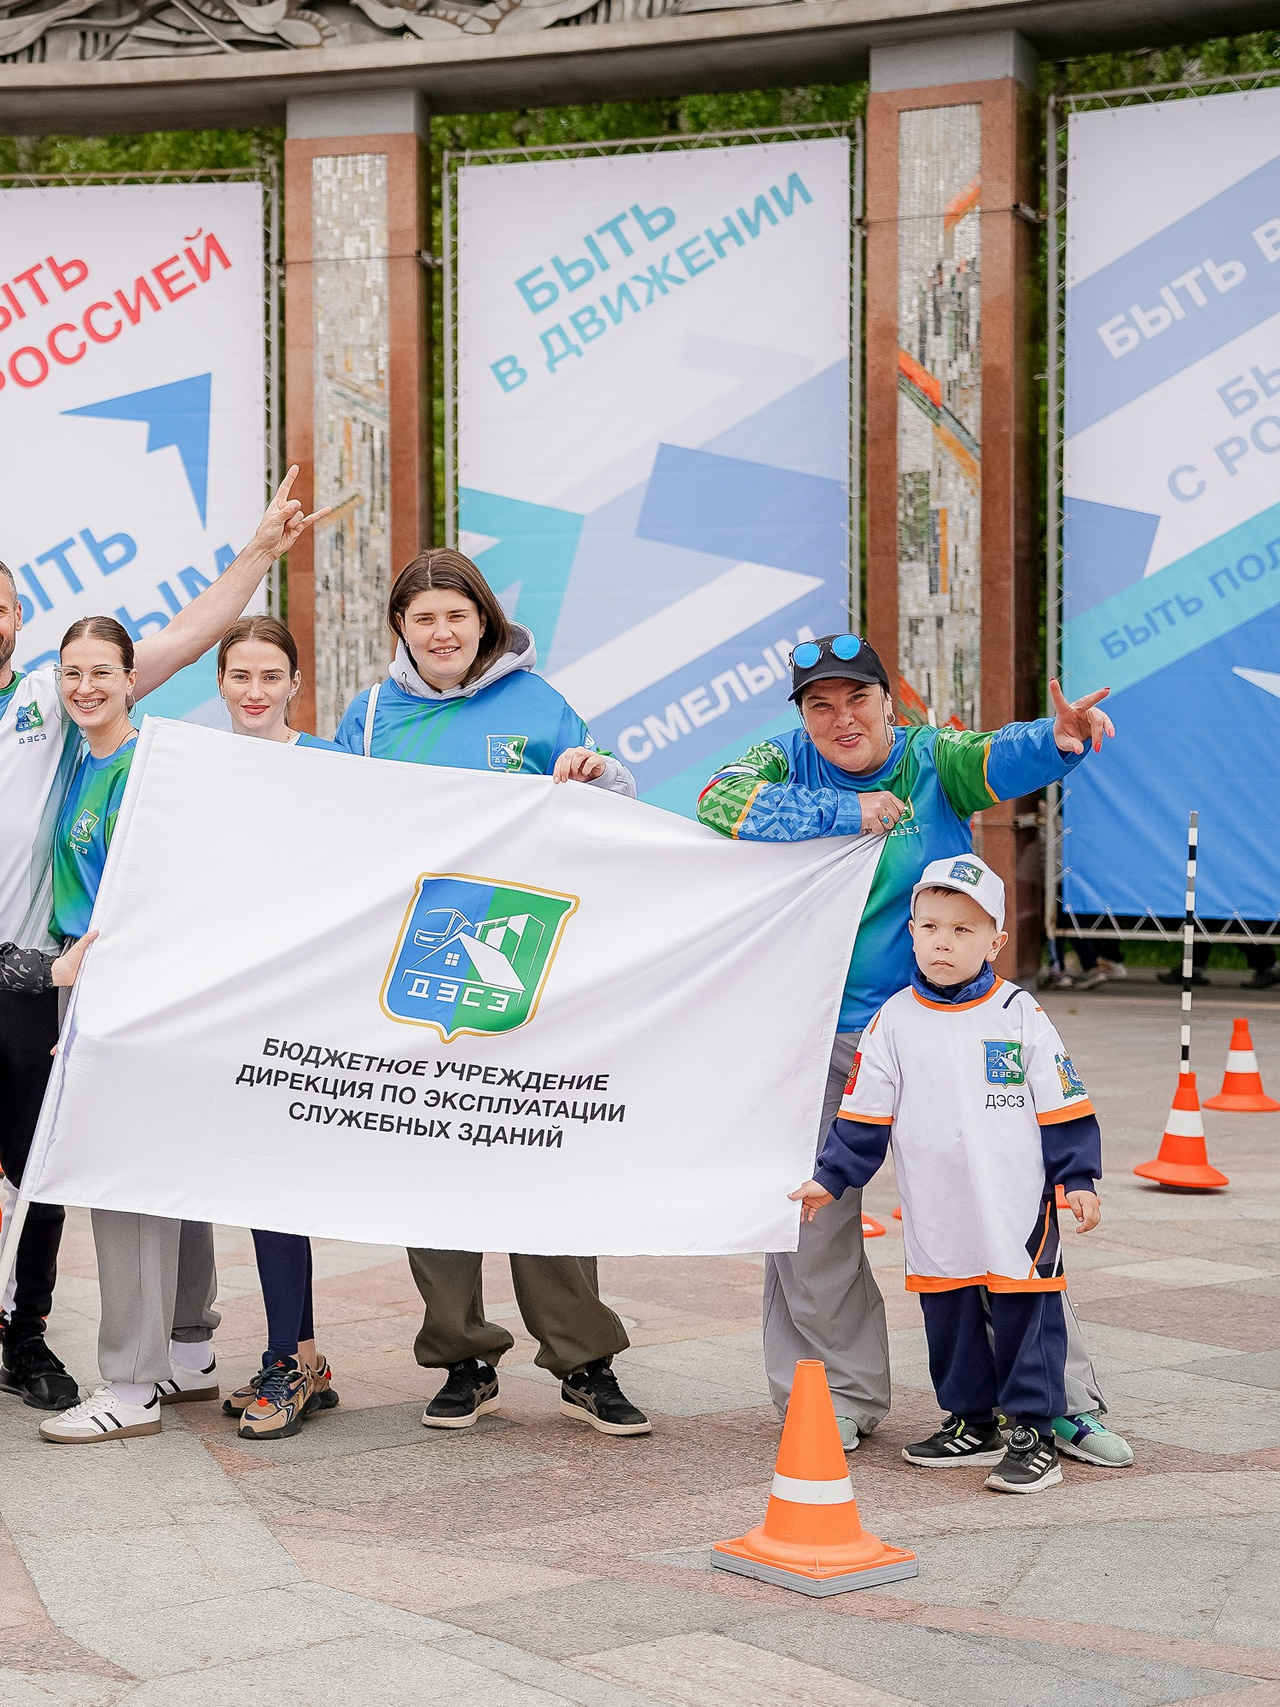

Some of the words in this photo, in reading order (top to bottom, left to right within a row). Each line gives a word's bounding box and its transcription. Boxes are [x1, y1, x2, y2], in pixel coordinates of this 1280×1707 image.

[489, 352, 526, 394] В
[539, 172, 813, 374] ДВИЖЕНИИ
[514, 203, 677, 315] БЫТЬ
[1096, 259, 1248, 360] БЫТЬ
[1167, 464, 1207, 503] С
[1099, 593, 1205, 660] БЫТЬ
[406, 977, 510, 1012] ДЭСЗ
[262, 1037, 428, 1077] БЮДЖЕТНОЕ
[434, 1061, 610, 1092] УЧРЕЖДЕНИЕ
[235, 1064, 375, 1100] ДИРЕКЦИЯ
[379, 1084, 417, 1106] ПО
[423, 1089, 626, 1124] ЭКСПЛУАТАЦИИ
[985, 1094, 1025, 1110] ДЭСЗ
[287, 1101, 452, 1139] СЛУЖЕБНЫХ
[458, 1122, 564, 1149] ЗДАНИЙ
